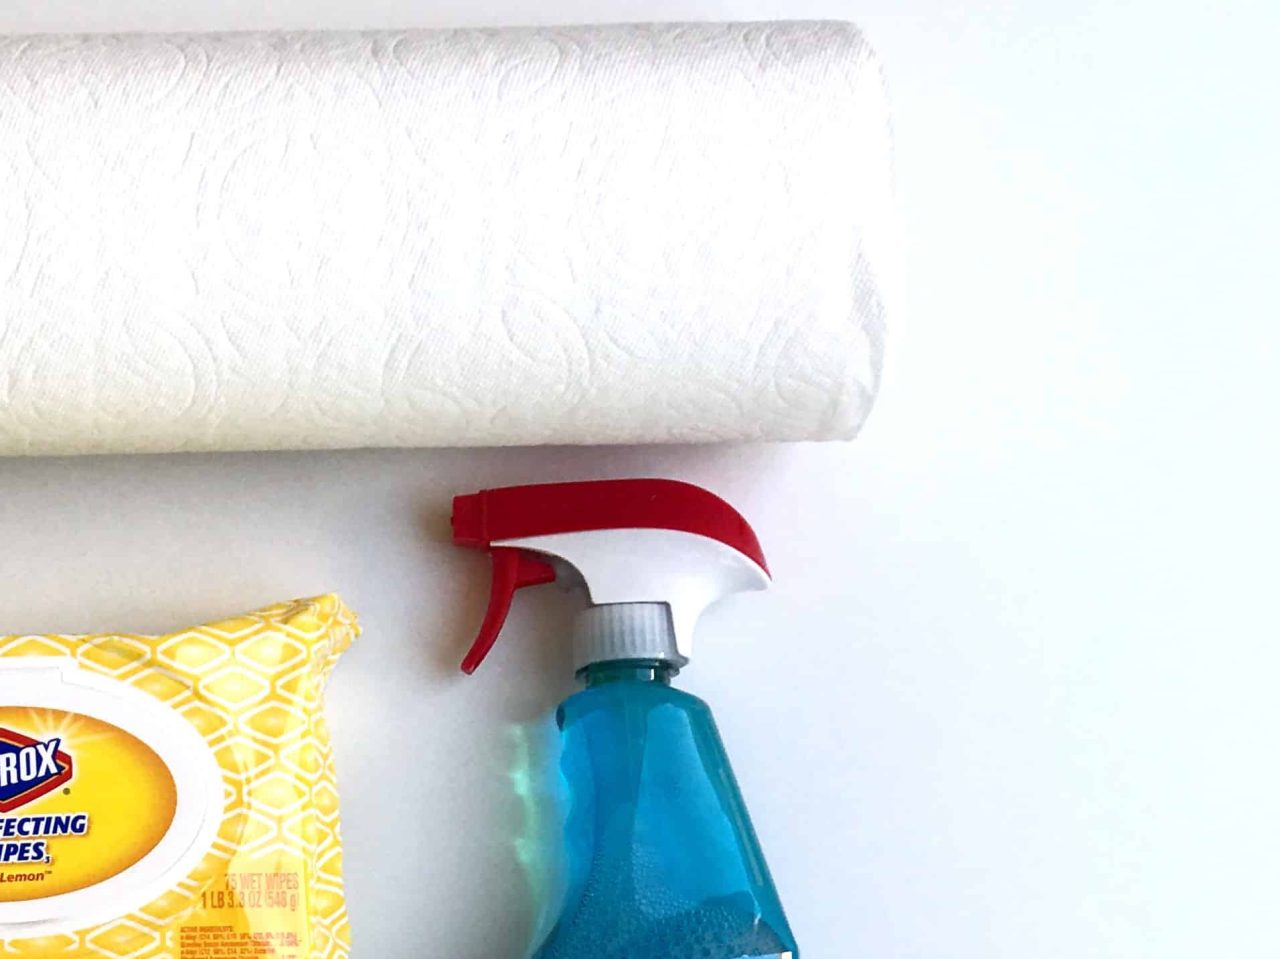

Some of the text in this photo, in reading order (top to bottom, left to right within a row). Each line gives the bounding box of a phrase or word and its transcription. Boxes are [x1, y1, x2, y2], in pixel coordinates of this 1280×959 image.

[240, 872, 263, 890] WET
[265, 872, 299, 890] WIPES
[201, 891, 207, 909] 1
[211, 891, 225, 909] LB
